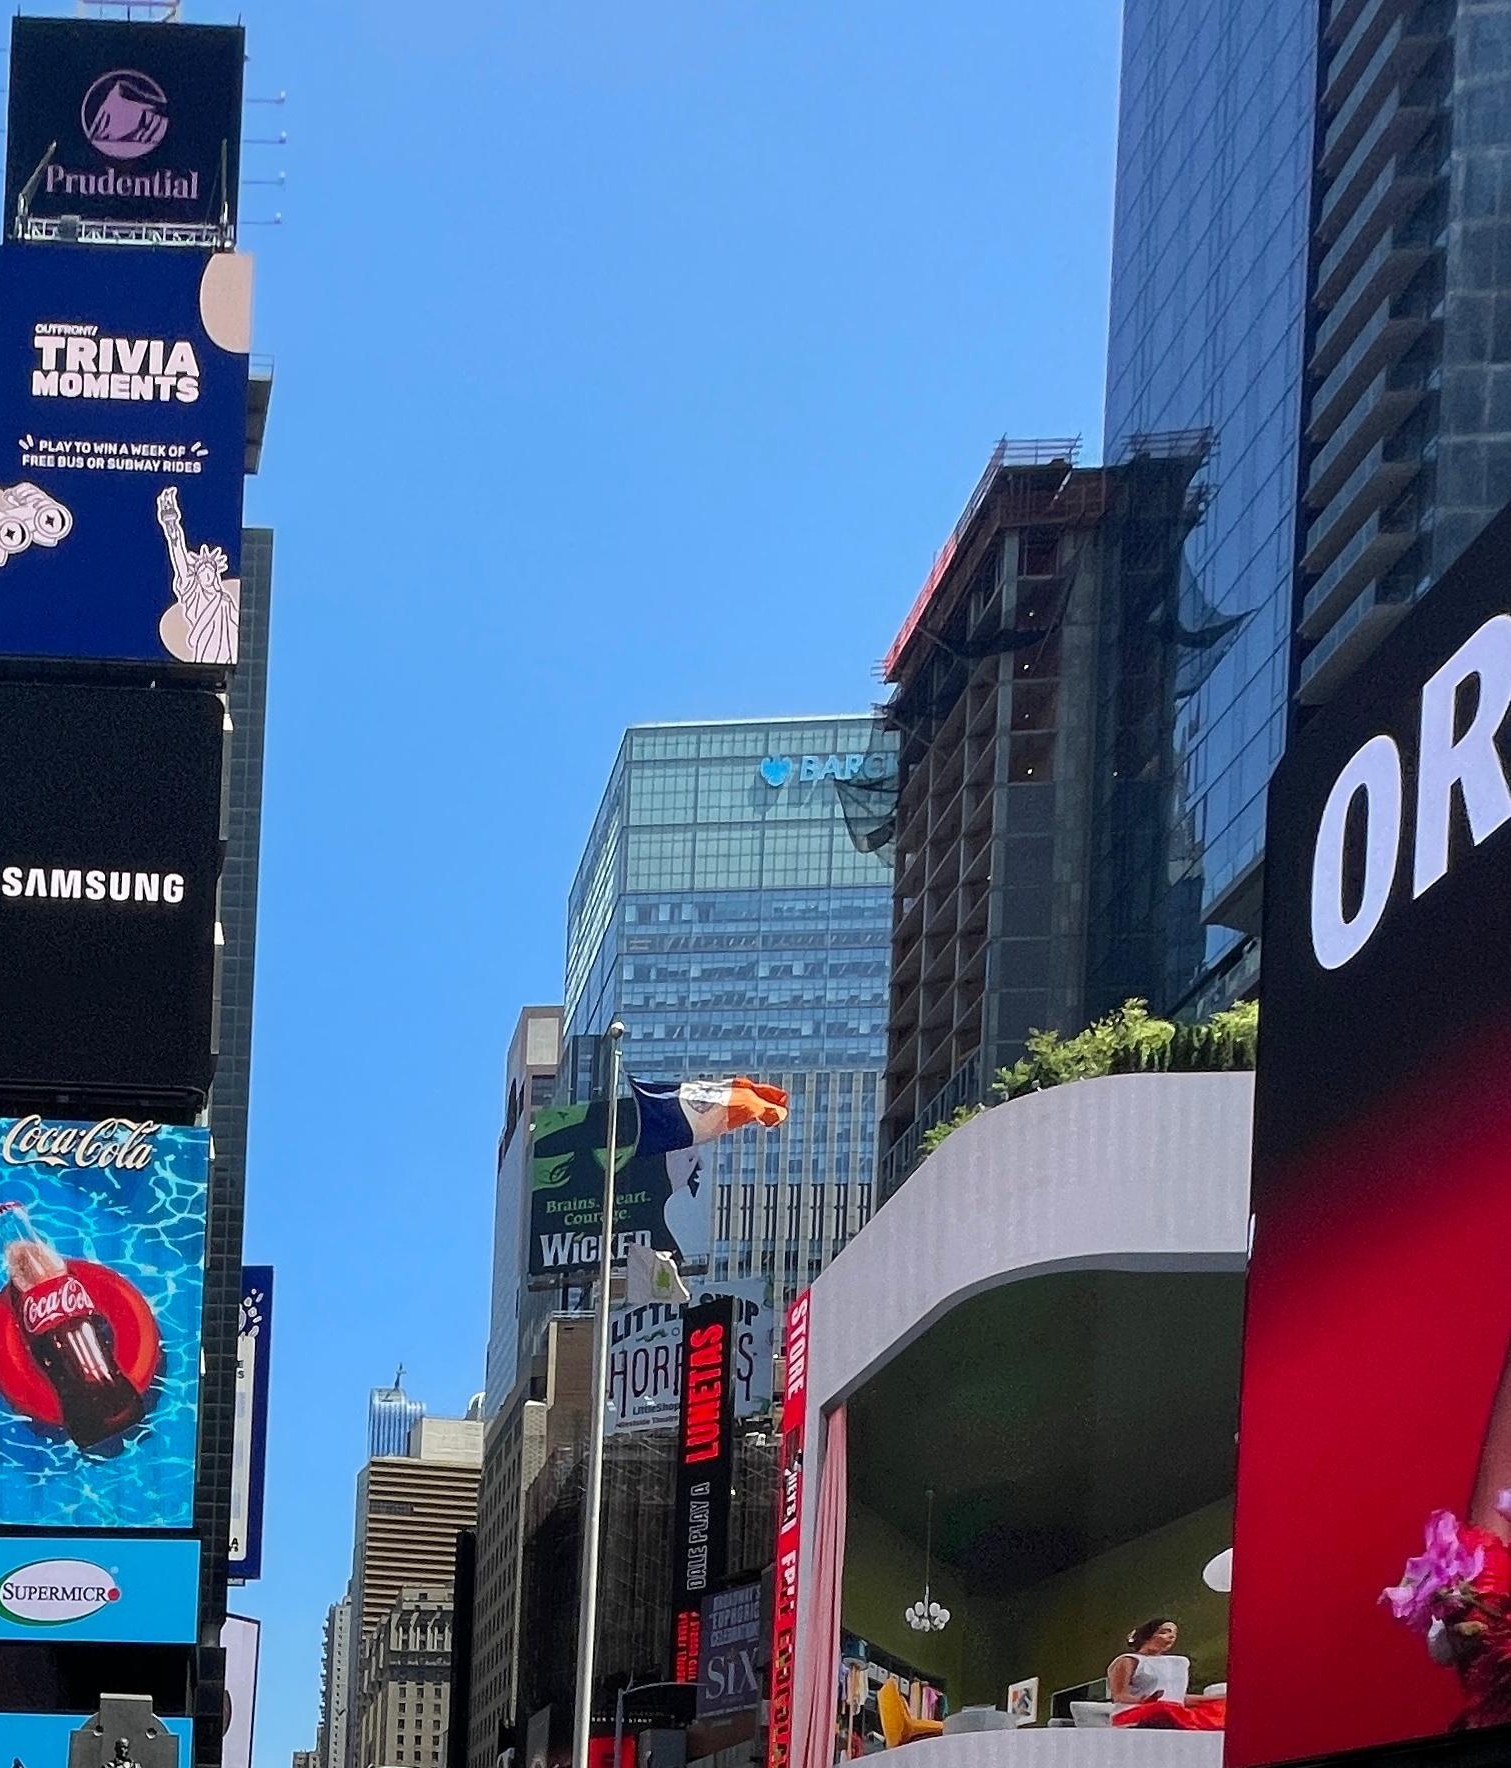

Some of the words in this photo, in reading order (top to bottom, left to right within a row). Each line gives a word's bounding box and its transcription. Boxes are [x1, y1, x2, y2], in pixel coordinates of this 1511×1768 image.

[46, 164, 199, 199] Prudential
[34, 336, 200, 378] TRIVIA
[32, 370, 200, 403] MOMENTS
[22, 453, 55, 468] FREE
[57, 456, 84, 469] BUS
[86, 456, 105, 470] OR
[106, 458, 161, 473] SUBWAY
[162, 459, 201, 473] RIDES
[39, 440, 72, 453] PLAY
[75, 441, 90, 454] TO
[93, 442, 116, 455] WIN
[115, 443, 129, 456] A
[131, 444, 166, 457] WEEK
[168, 445, 186, 457] OF
[1, 866, 185, 904] SAMSUNG
[788, 1298, 808, 1400] STORE
